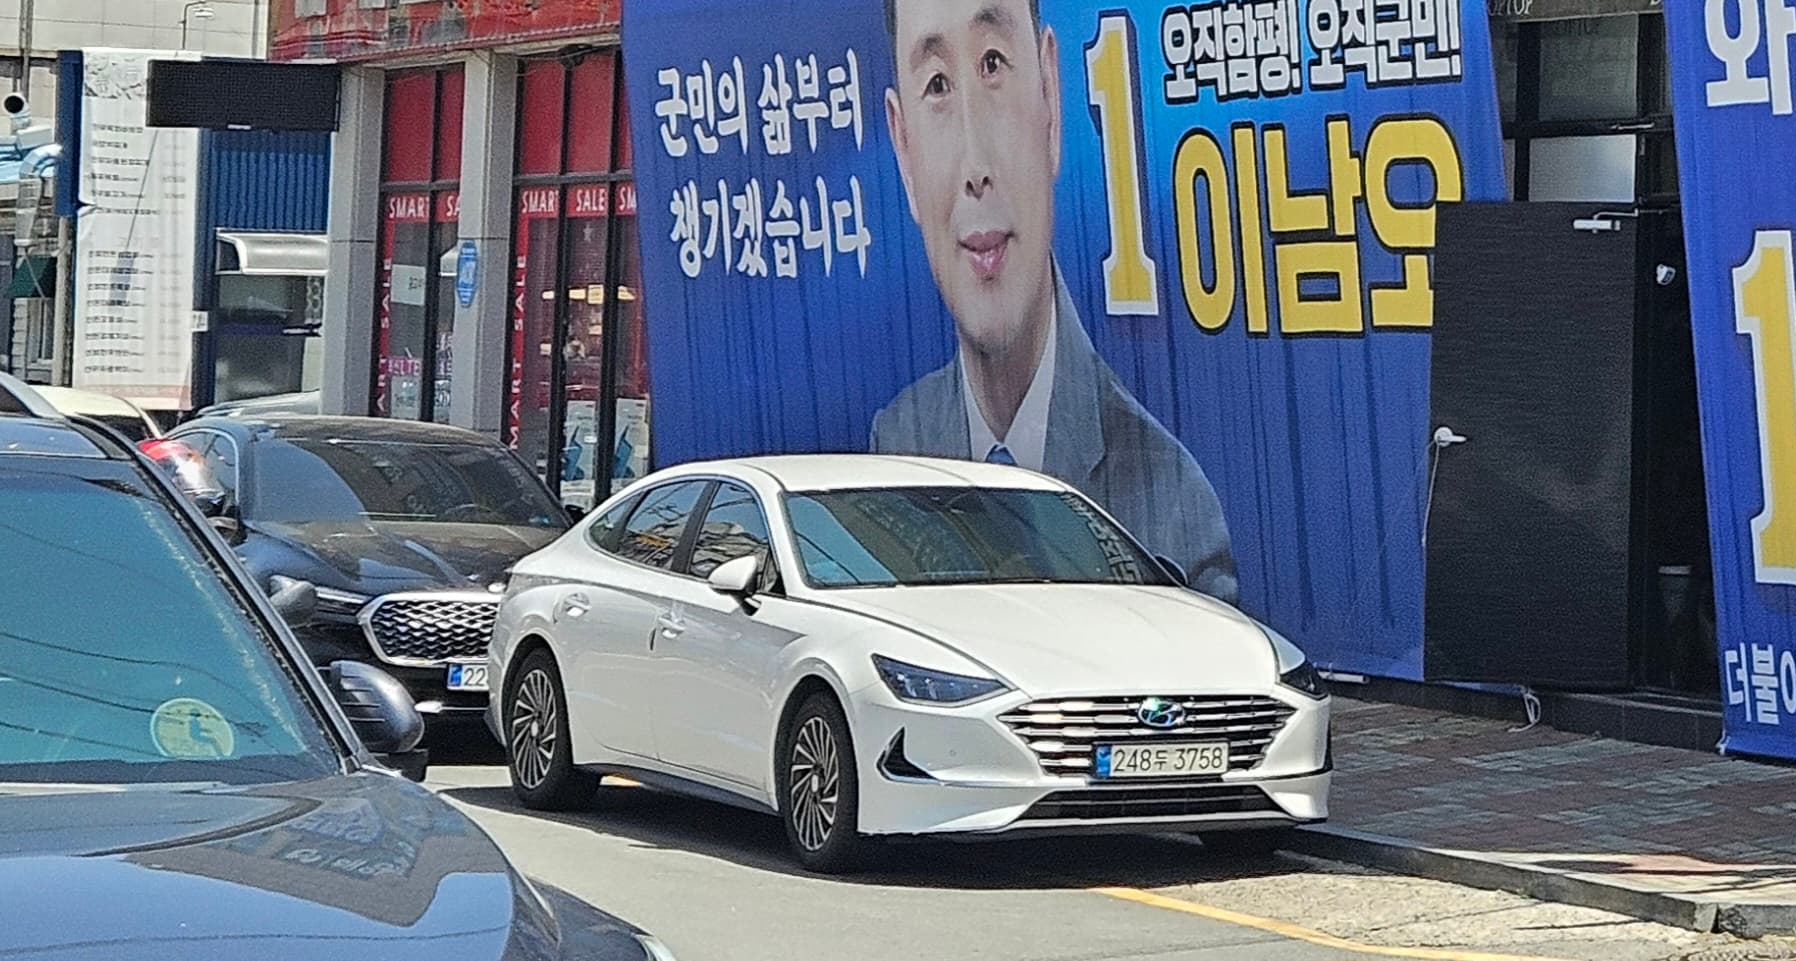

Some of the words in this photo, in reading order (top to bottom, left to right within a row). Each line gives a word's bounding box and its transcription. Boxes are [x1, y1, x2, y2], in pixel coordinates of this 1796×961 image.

[655, 56, 749, 158] 군민의
[757, 47, 864, 153] 삶부터
[576, 188, 606, 212] SALE
[1086, 12, 1162, 316] 1
[669, 175, 871, 279] 챙기겠습니다
[1171, 112, 1464, 336] 이남오
[514, 256, 528, 331] SALE
[509, 360, 523, 450] MART
[1113, 747, 1168, 773] 248두
[1173, 745, 1224, 771] 3758
